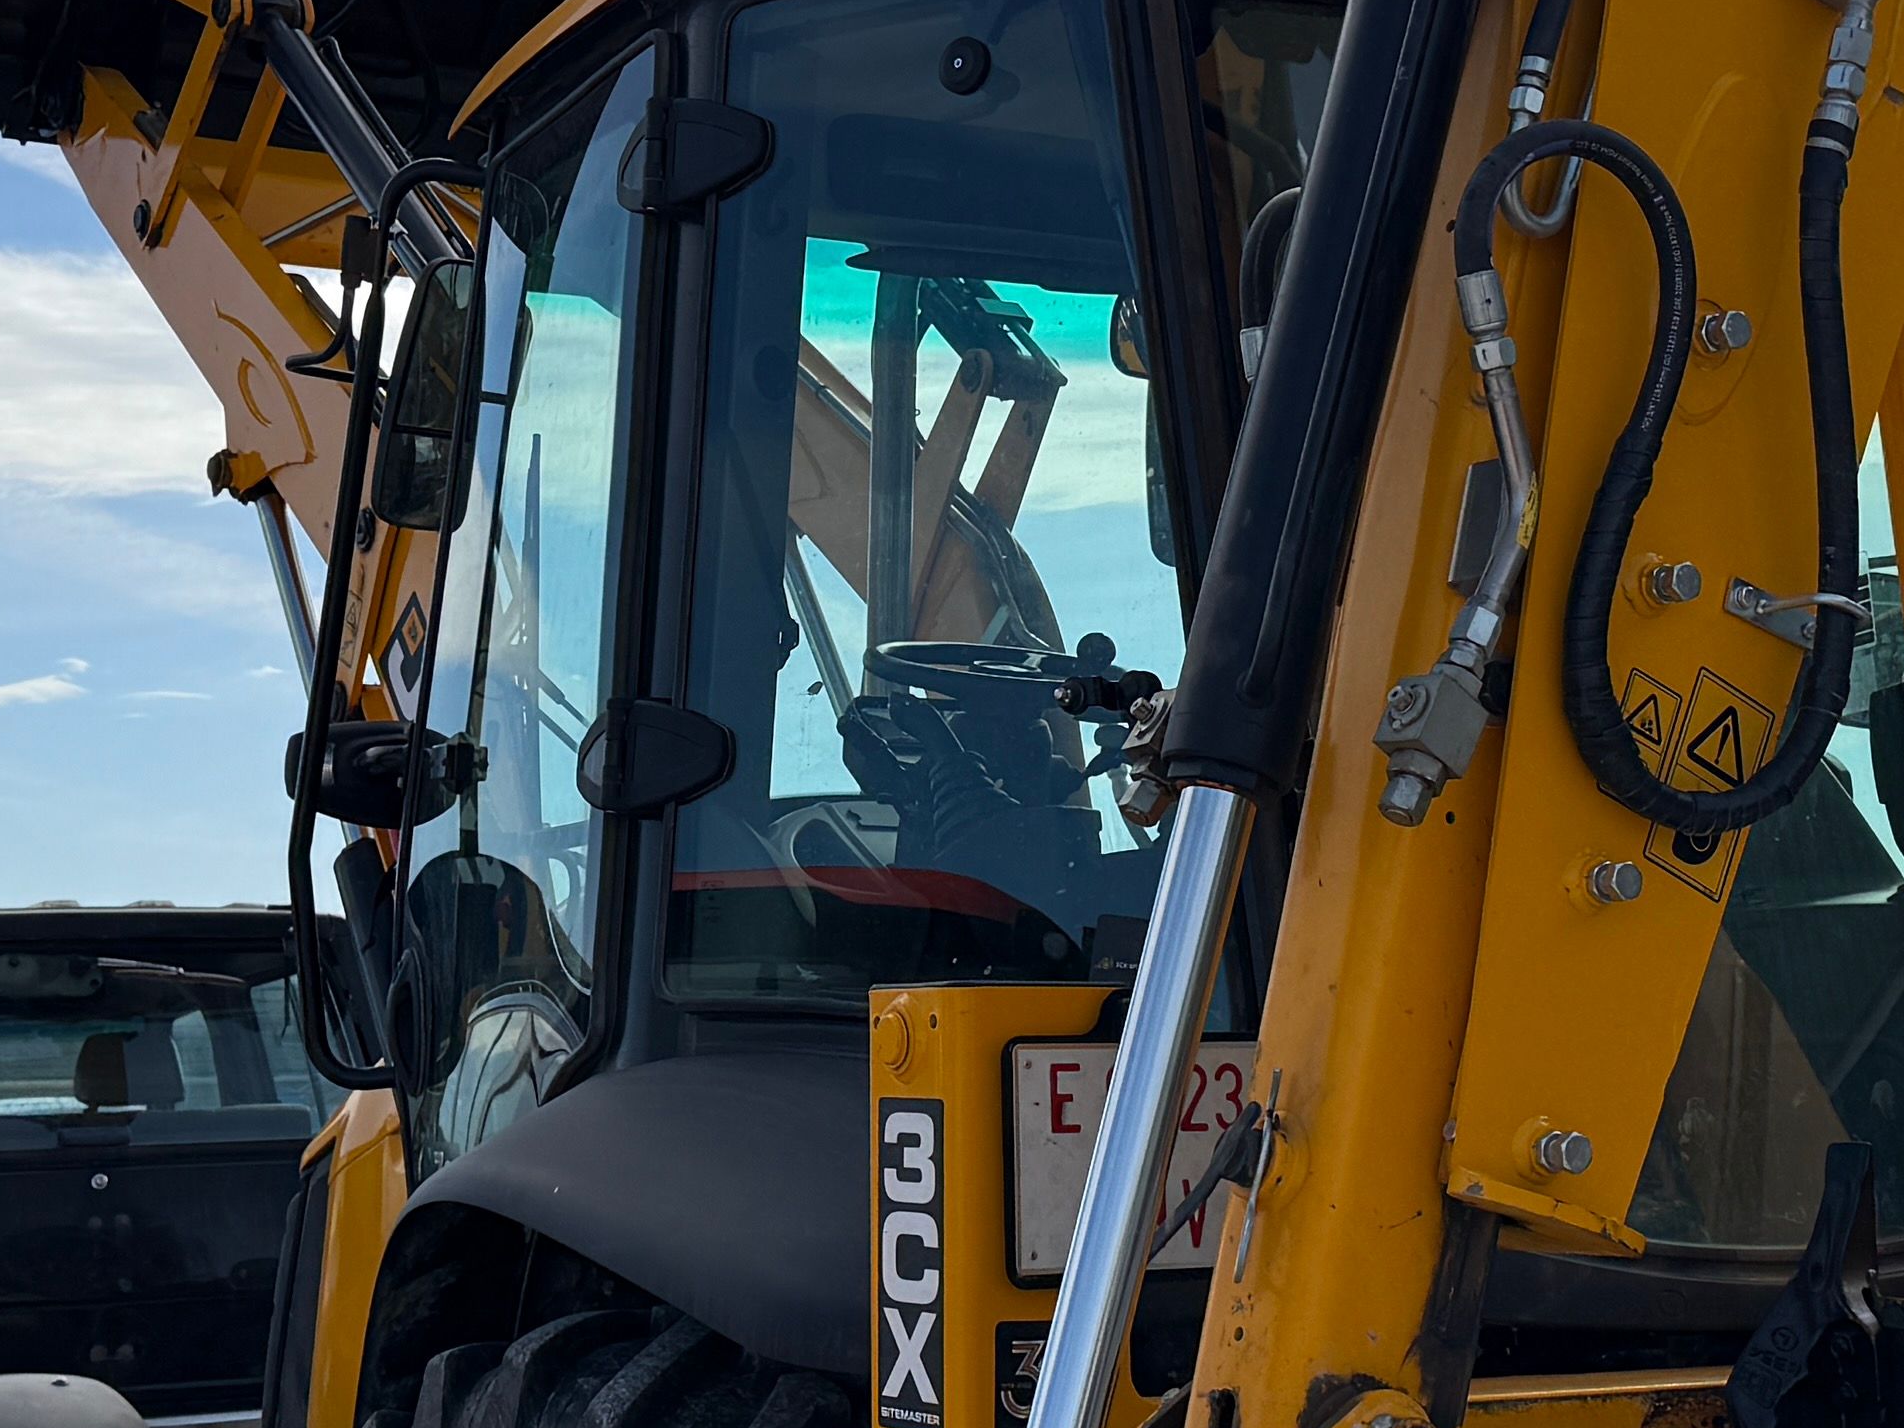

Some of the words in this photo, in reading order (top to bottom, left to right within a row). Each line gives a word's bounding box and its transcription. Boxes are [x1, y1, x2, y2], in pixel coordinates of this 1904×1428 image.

[1049, 1062, 1082, 1133] E
[881, 1112, 940, 1405] 3CX
[880, 1406, 941, 1427] SITEMASTER
